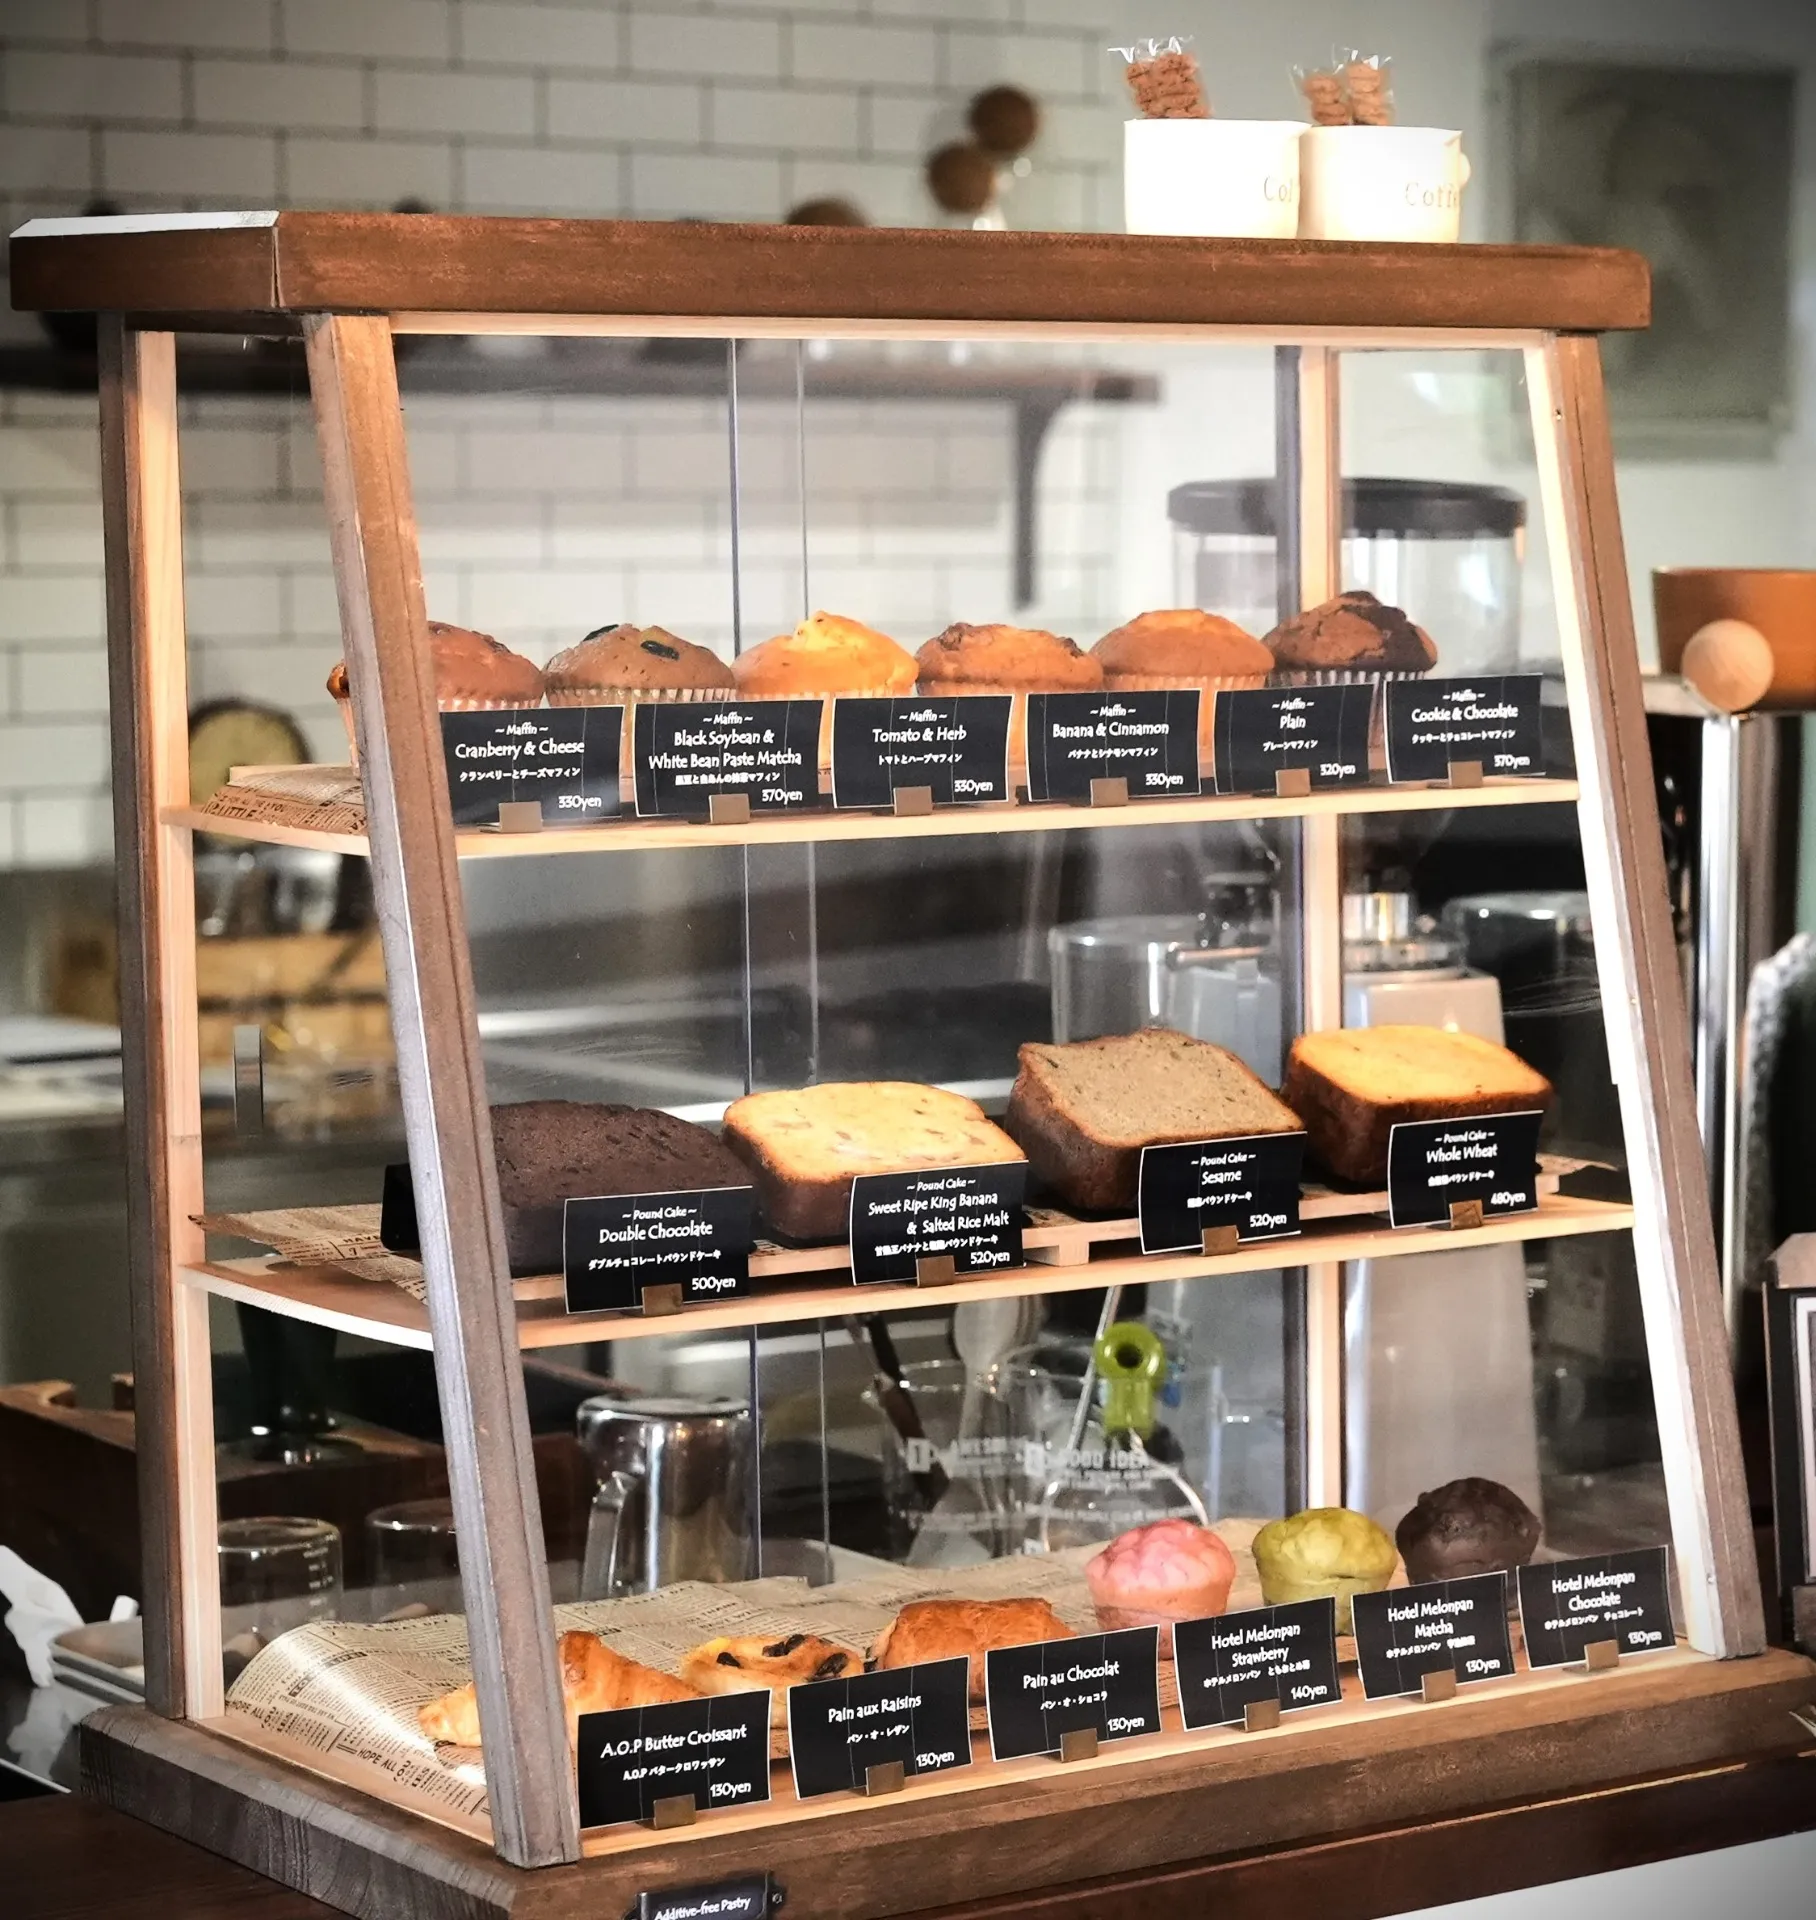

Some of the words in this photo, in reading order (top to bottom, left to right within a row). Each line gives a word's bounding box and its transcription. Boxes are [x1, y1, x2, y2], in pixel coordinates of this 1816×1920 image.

[1280, 713, 1306, 729] Plain
[1411, 706, 1451, 723] Cookie
[1452, 707, 1463, 721] &
[1464, 702, 1519, 720] Chocolate
[872, 728, 920, 743] Tomato
[922, 727, 934, 742] &
[936, 724, 967, 741] Herb
[1052, 723, 1094, 738] Banana
[1095, 722, 1107, 737] &
[1109, 721, 1169, 737] Cinnamon
[674, 729, 707, 747] Black
[709, 728, 760, 749] Soybean
[763, 729, 775, 744] &
[1262, 740, 1318, 752] プレーンマフィン
[455, 741, 522, 760] Cranberry
[523, 741, 536, 756] &
[538, 738, 585, 755] Cheese
[1067, 747, 1159, 760] バナナとシナモンマフィン
[649, 752, 688, 770] White
[690, 753, 720, 769] Bean
[723, 751, 755, 767] Paste
[757, 748, 802, 765] Matcha
[879, 752, 962, 766] トマトとハーブマフィン
[1494, 754, 1531, 770] 370yen
[460, 767, 581, 782] クランベリーとチーズマフィン
[1320, 763, 1356, 779] 320yen
[954, 779, 994, 795] 330yen
[1145, 773, 1184, 789] 330yen
[558, 795, 602, 811] 330yen
[761, 788, 803, 805] 370yen
[1200, 1154, 1227, 1166] Pound
[1227, 1152, 1247, 1164] Cake
[1426, 1145, 1461, 1163] Whole
[1463, 1143, 1498, 1160] Wheat
[917, 1179, 944, 1192] Pound
[946, 1177, 967, 1189] Cake
[1202, 1170, 1242, 1185] Sesame
[868, 1199, 902, 1216] Sweet
[903, 1198, 928, 1215] Ripe
[930, 1195, 957, 1211] King
[959, 1192, 998, 1207] Banana
[1490, 1191, 1527, 1206] 480yen
[633, 1207, 663, 1220] Pound
[664, 1206, 687, 1219] Cake
[1249, 1213, 1287, 1229] 520yen
[906, 1221, 917, 1235] &
[922, 1216, 955, 1234] Salted
[957, 1215, 982, 1230] Rice
[983, 1210, 1010, 1227] Malt
[599, 1223, 646, 1244] Double
[648, 1219, 713, 1240] Chocolate
[588, 1249, 722, 1270] ダブルチョコレートパウンドケーキ
[970, 1250, 1011, 1266] 520yen
[691, 1276, 736, 1292] 500yen
[1552, 1574, 1582, 1593] Hotel
[1584, 1571, 1636, 1589] Melonpan
[1568, 1591, 1621, 1611] Chocolate
[1387, 1602, 1419, 1622] Hotel
[1420, 1598, 1474, 1615] Melonpan
[1415, 1618, 1454, 1638] Matcha
[1211, 1629, 1244, 1650] Hotel
[1246, 1624, 1301, 1643] Melonpan
[1232, 1646, 1289, 1668] Strawberry
[1023, 1674, 1048, 1689] Pain
[1050, 1672, 1065, 1686] au
[1067, 1660, 1120, 1682] Chocolat
[1465, 1658, 1501, 1674] 130yen
[1203, 1669, 1261, 1688] ホテルメロンパン
[1291, 1685, 1328, 1700] 140yen
[828, 1706, 855, 1723] Pain
[856, 1703, 880, 1719] aux
[881, 1695, 922, 1713] Raisins
[1107, 1717, 1145, 1732] 130yen
[600, 1738, 642, 1758] A.O.P
[645, 1733, 686, 1752] Butter
[687, 1724, 747, 1746] Croissant
[358, 1748, 382, 1765] HOPE
[381, 1759, 397, 1772] ALL
[916, 1751, 955, 1767] 130yen
[623, 1768, 648, 1780] A.O.P
[649, 1757, 726, 1776] バタークロワッサン
[709, 1782, 752, 1798] 130yen
[653, 1900, 720, 1920] Additive-free
[720, 1897, 752, 1912] Pastry
